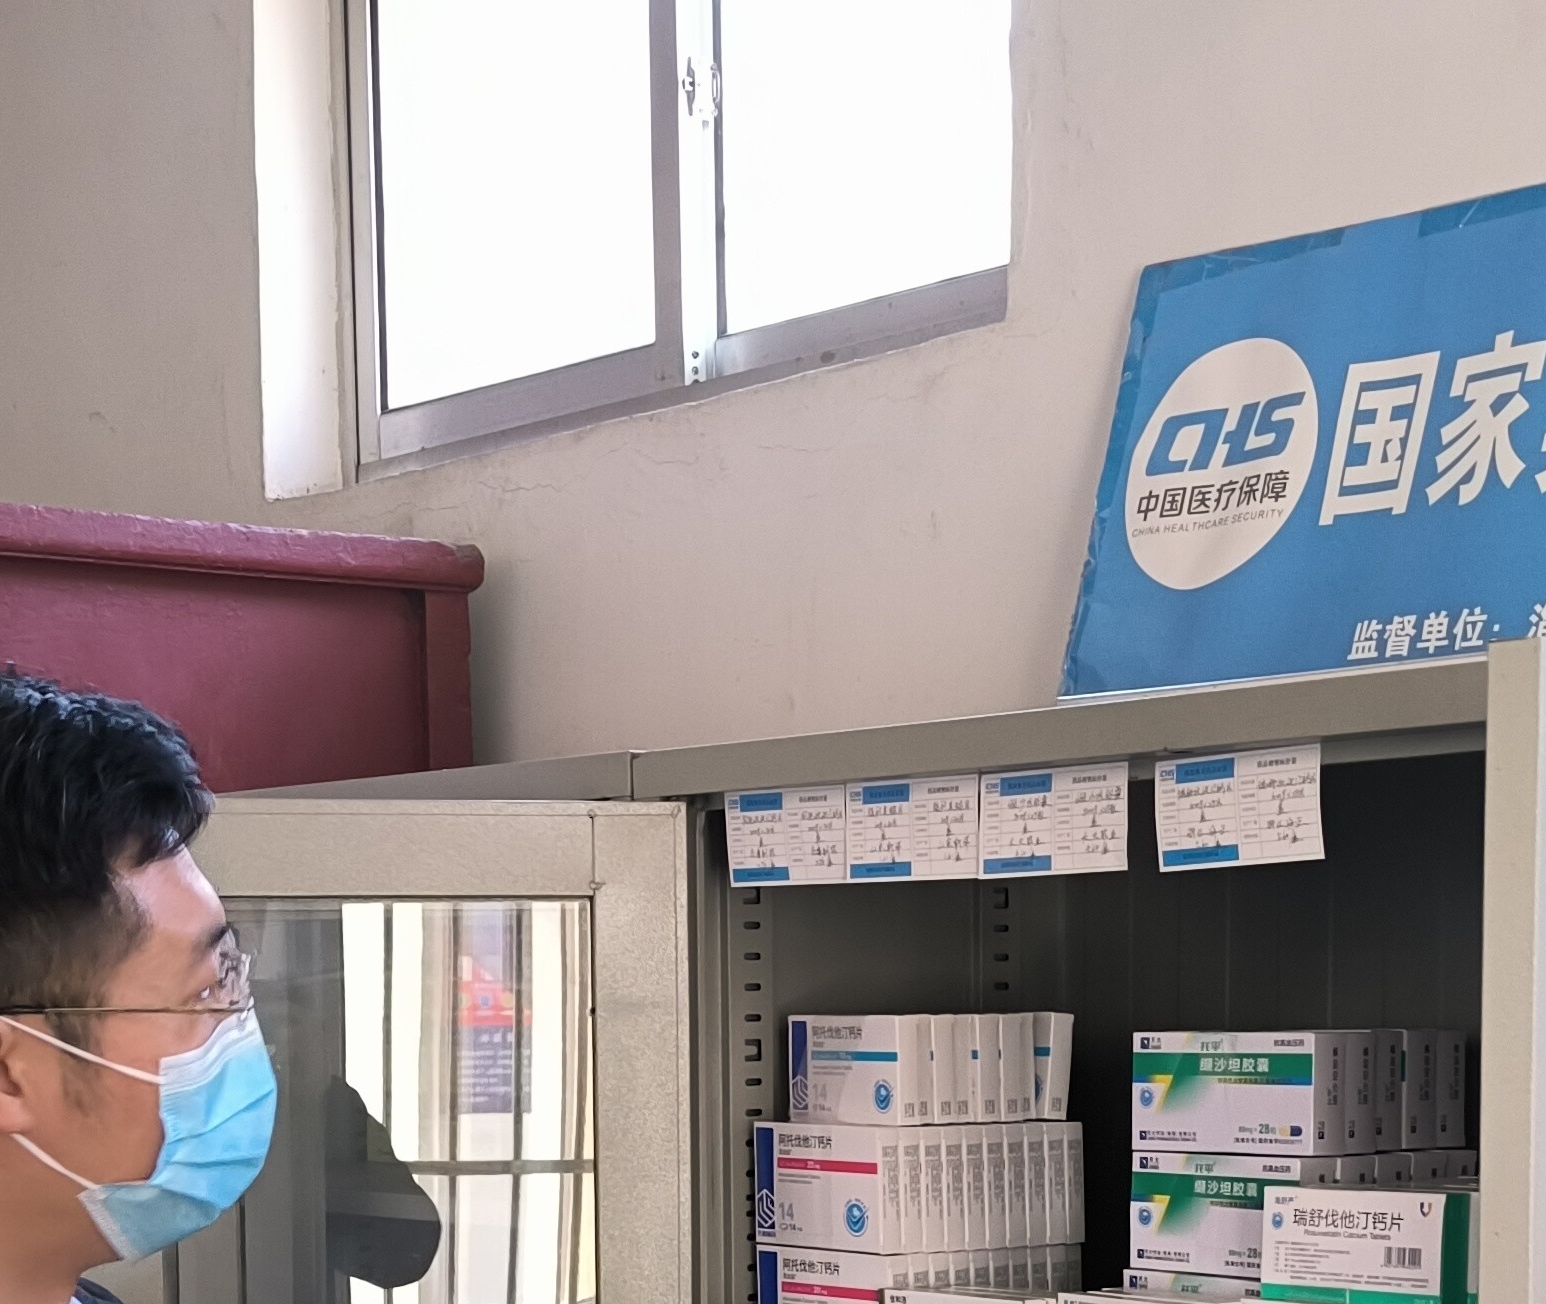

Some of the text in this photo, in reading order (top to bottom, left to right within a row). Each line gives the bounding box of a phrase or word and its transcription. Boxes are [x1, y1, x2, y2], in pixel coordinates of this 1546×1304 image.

[1136, 470, 1290, 522] 中国医疗保障
[1131, 526, 1161, 539] CHINA
[1231, 508, 1285, 526] SECURITY
[778, 1202, 795, 1221] 14
[1293, 1208, 1405, 1233] 瑞舒伐他汀钙片
